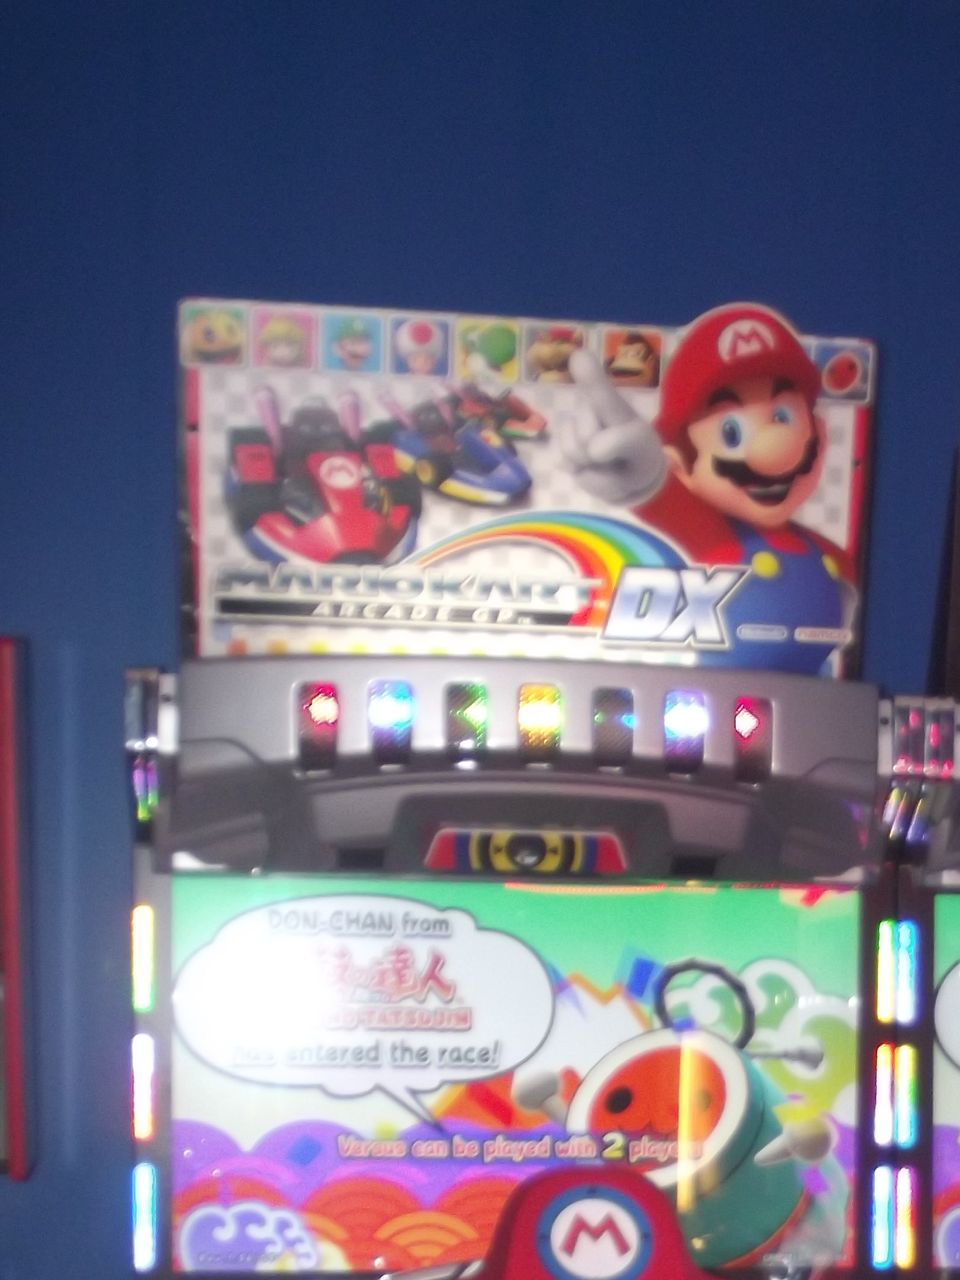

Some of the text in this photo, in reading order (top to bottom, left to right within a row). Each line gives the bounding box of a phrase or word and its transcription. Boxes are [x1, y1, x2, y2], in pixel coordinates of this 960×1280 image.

[312, 602, 452, 622] ARCADE
[603, 566, 752, 646] DX
[267, 909, 450, 932] DON-CHAN from
[286, 1041, 380, 1064] entered
[390, 1041, 429, 1064] the
[438, 1040, 500, 1064] race!
[337, 1132, 701, 1163] Versus can be played with 2 playe
